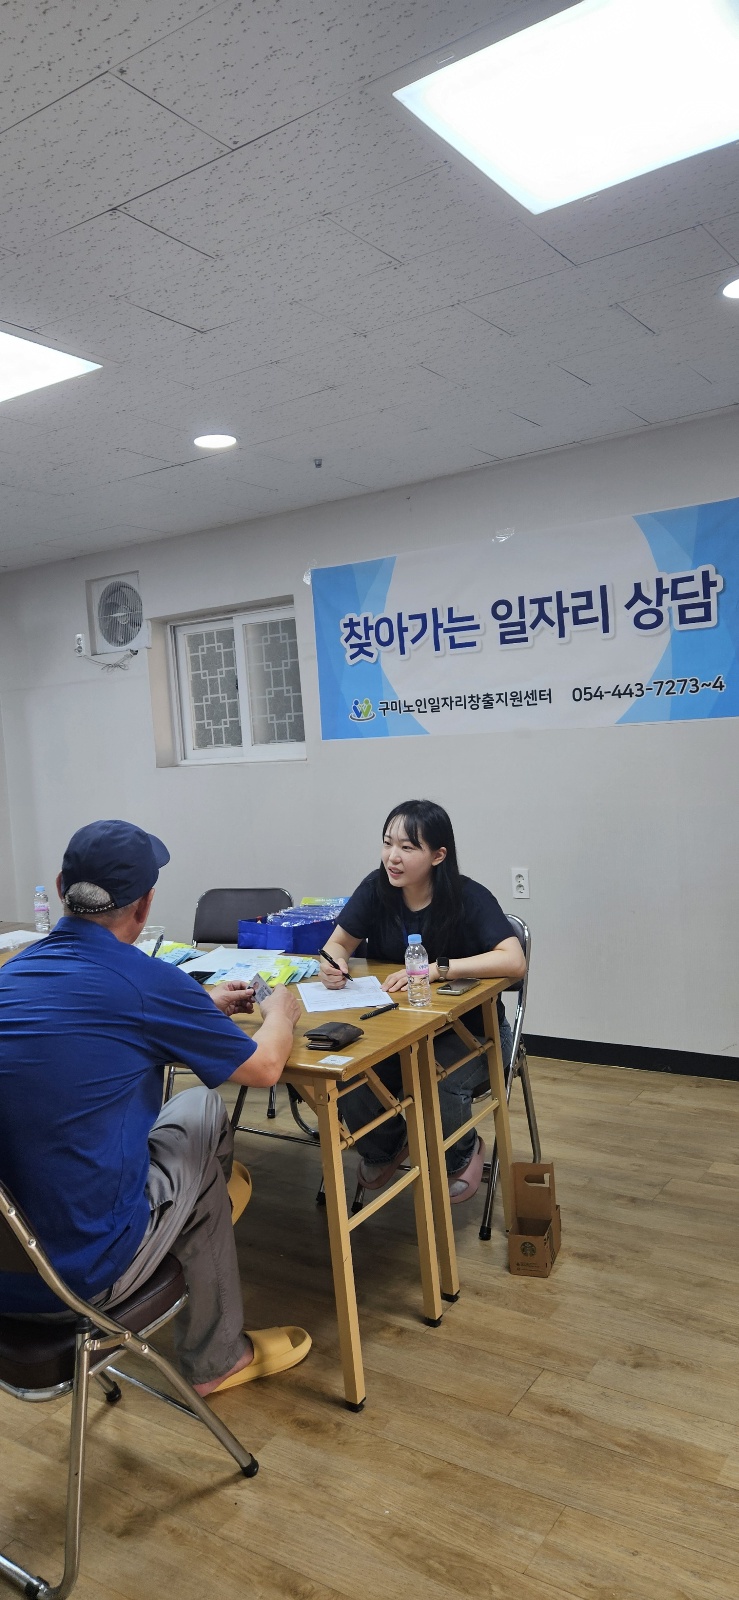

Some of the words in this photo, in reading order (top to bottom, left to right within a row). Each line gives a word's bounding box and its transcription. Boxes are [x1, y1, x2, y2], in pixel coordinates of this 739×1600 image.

[343, 607, 481, 660] 찾아가는
[491, 585, 610, 644] 일자리
[624, 570, 718, 631] 상담
[378, 688, 552, 716] 구미노인일자리창출지원센터
[571, 675, 725, 702] 054-443-7273~4
